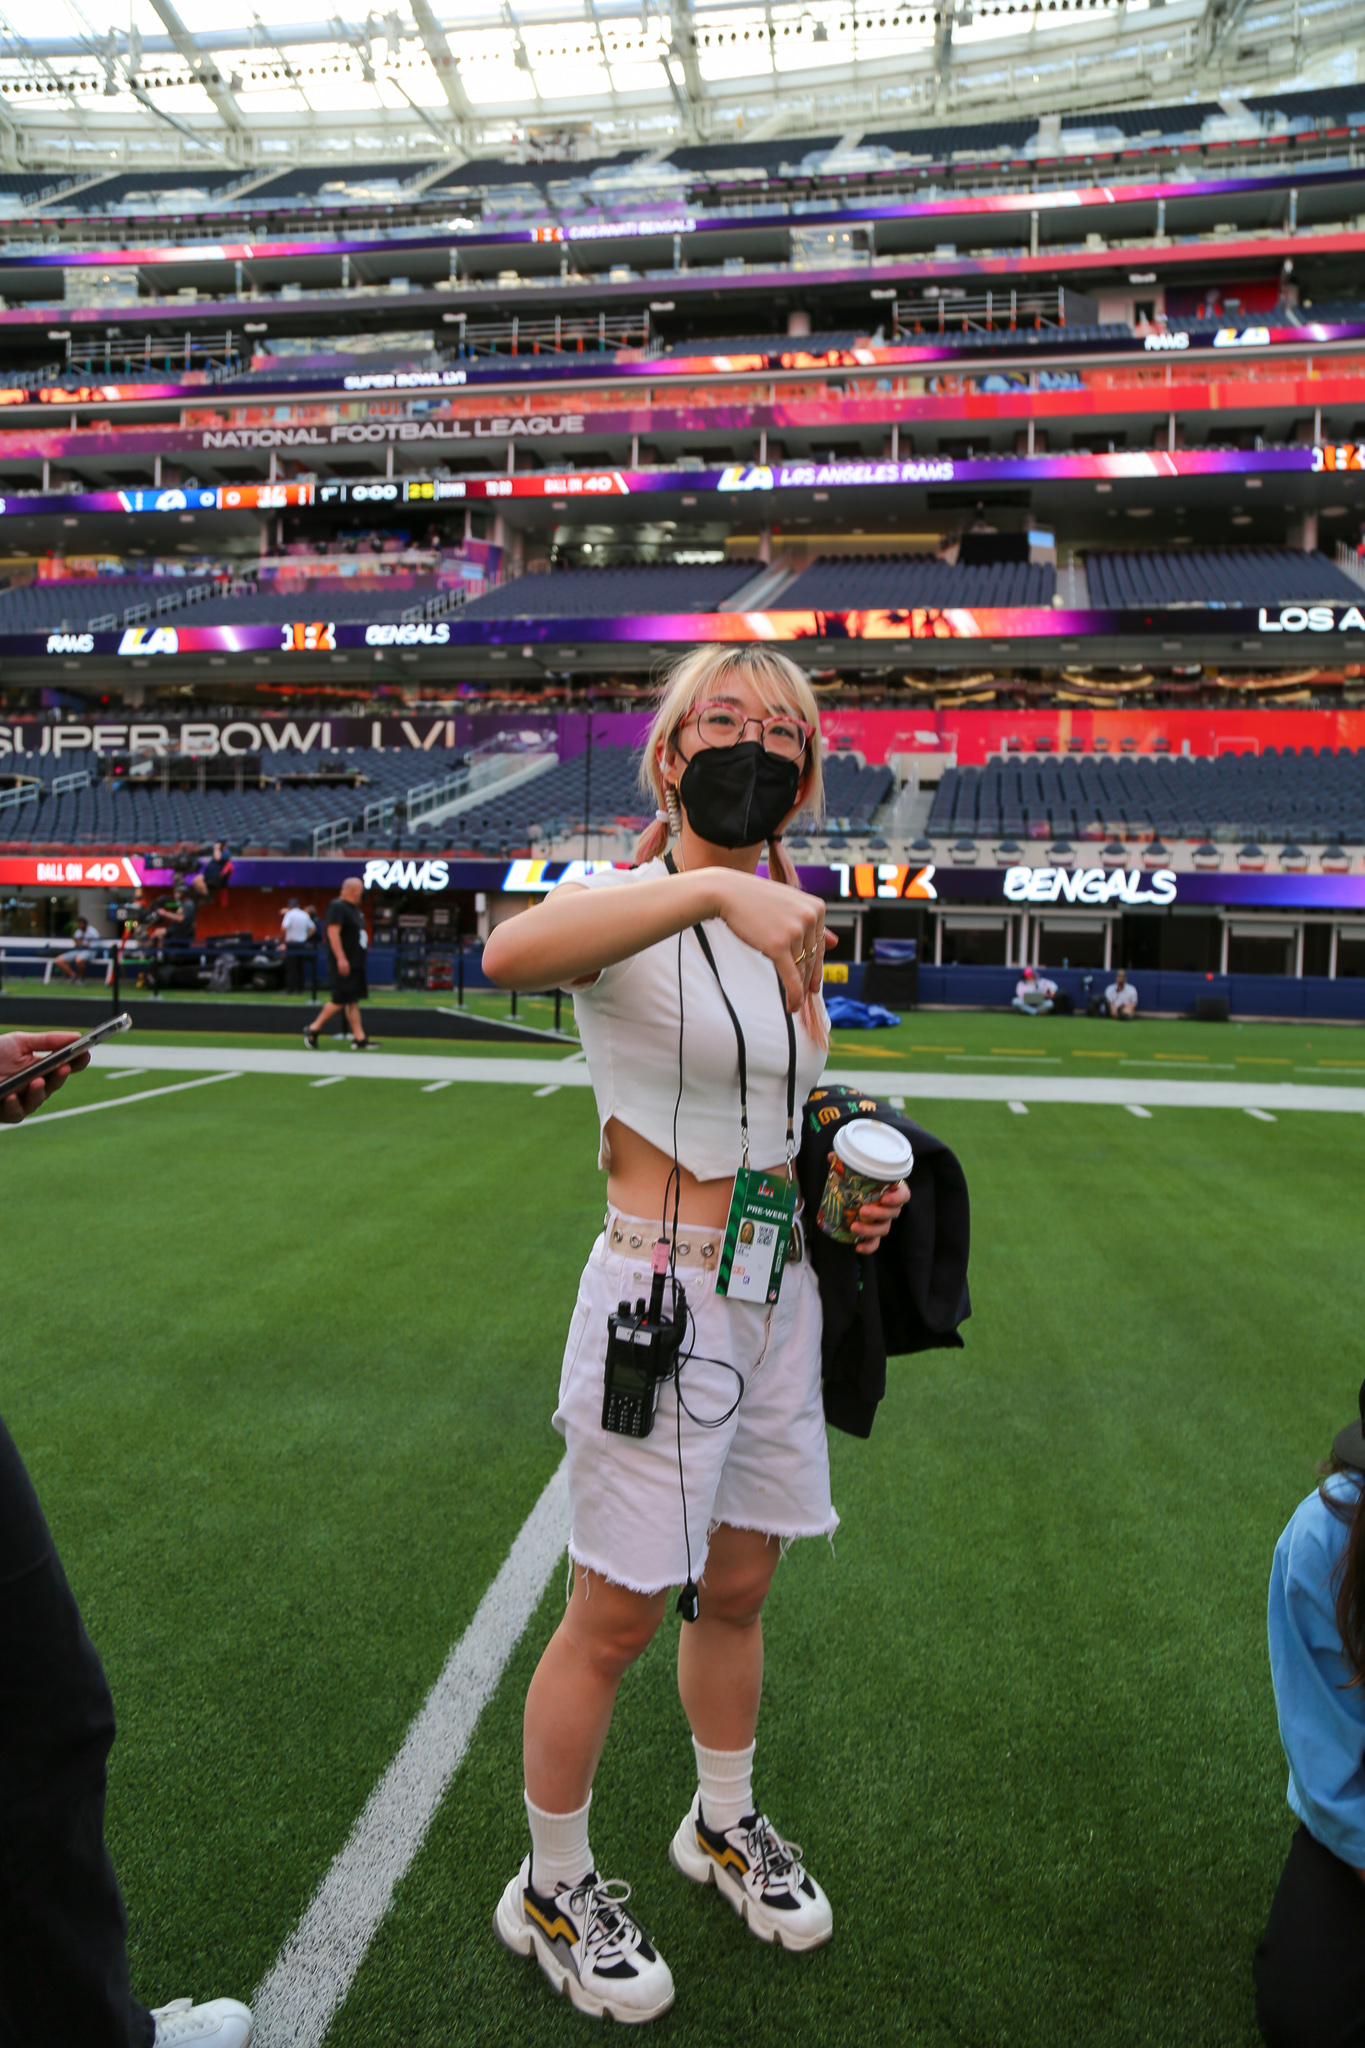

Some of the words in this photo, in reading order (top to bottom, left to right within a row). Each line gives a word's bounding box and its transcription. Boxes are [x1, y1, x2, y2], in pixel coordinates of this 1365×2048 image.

[1144, 331, 1189, 351] RAMS
[343, 374, 395, 391] SUPER
[396, 371, 442, 388] BOWL
[202, 427, 328, 449] NATIONAL
[331, 420, 471, 444] FOOTBALL
[474, 414, 585, 438] LEAGUE
[583, 476, 613, 492] 40
[780, 467, 816, 487] LOS
[816, 464, 899, 486] ANGELES
[901, 461, 955, 482] RAMS
[352, 484, 398, 502] 0:00
[1258, 606, 1335, 632] LOS
[46, 633, 95, 654] RAMS
[364, 622, 451, 646] BENGALS
[36, 862, 65, 882] BALL
[84, 862, 120, 883] 40
[363, 858, 449, 891] RAMS
[1003, 866, 1177, 905] BENGALS
[746, 1203, 789, 1222] PRE-WEEK
